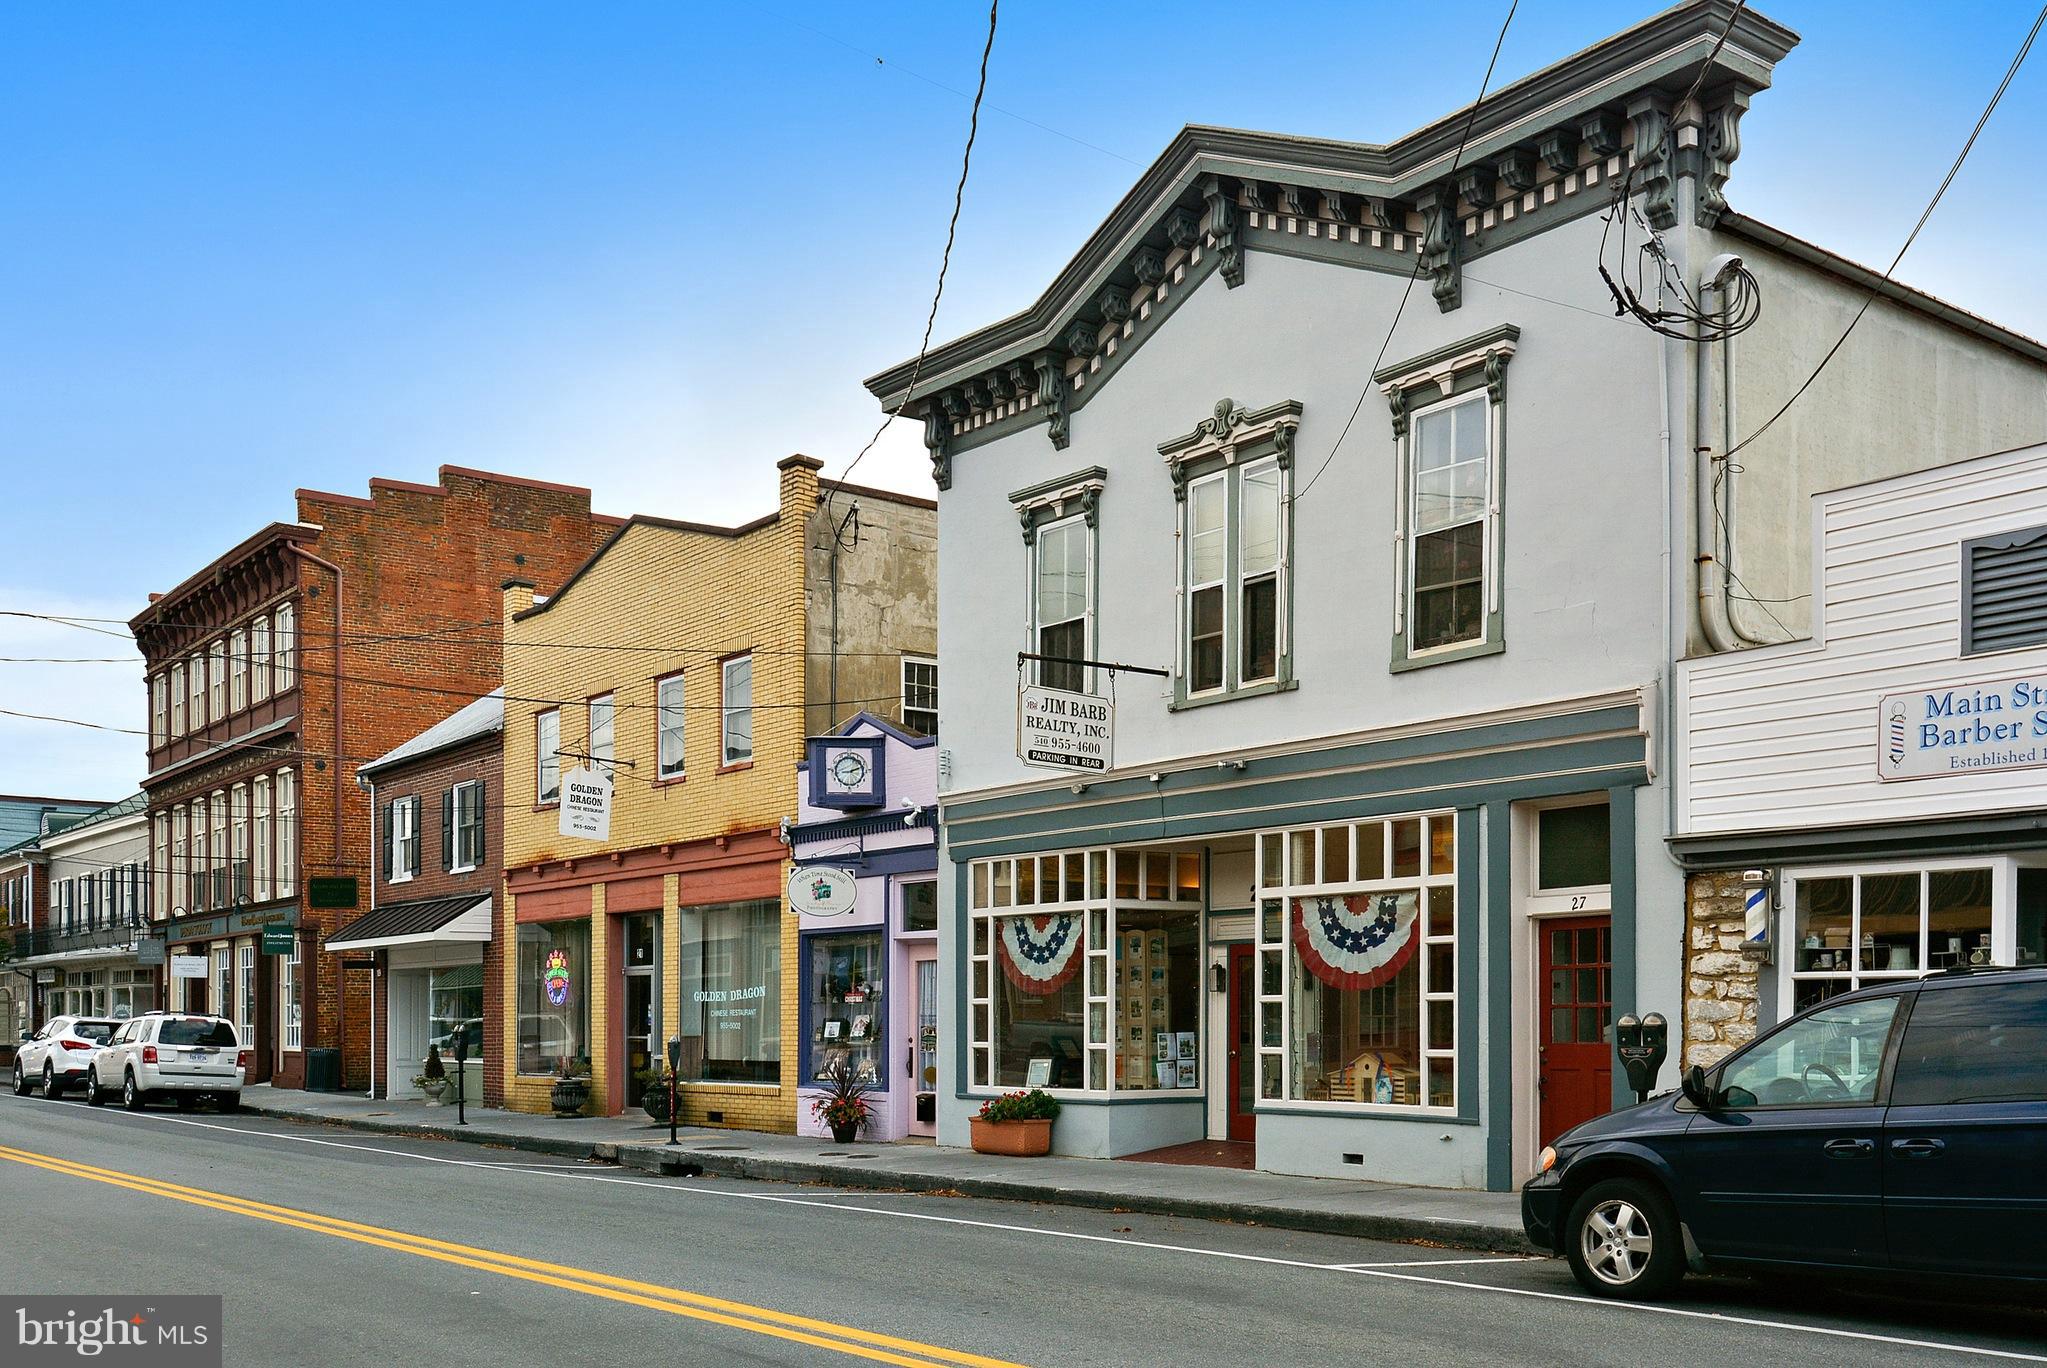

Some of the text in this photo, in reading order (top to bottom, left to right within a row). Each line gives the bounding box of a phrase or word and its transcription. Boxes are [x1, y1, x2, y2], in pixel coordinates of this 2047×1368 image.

[1041, 697, 1107, 721] JIM BARB
[1924, 690, 2003, 720] Main
[1026, 715, 1110, 739] REALTY, INC.
[1920, 718, 2023, 750] Barber
[1034, 736, 1101, 754] 540 955-4600
[1032, 752, 1101, 768] PARKING IN REAR
[1951, 747, 2036, 770] Established
[570, 783, 603, 795] GOLDEN
[570, 794, 603, 806] DRAGON
[1572, 896, 1586, 910] 27
[693, 986, 766, 1002] GOLDEN DRAGON
[711, 1008, 756, 1017] CHINESE RESTAURANT
